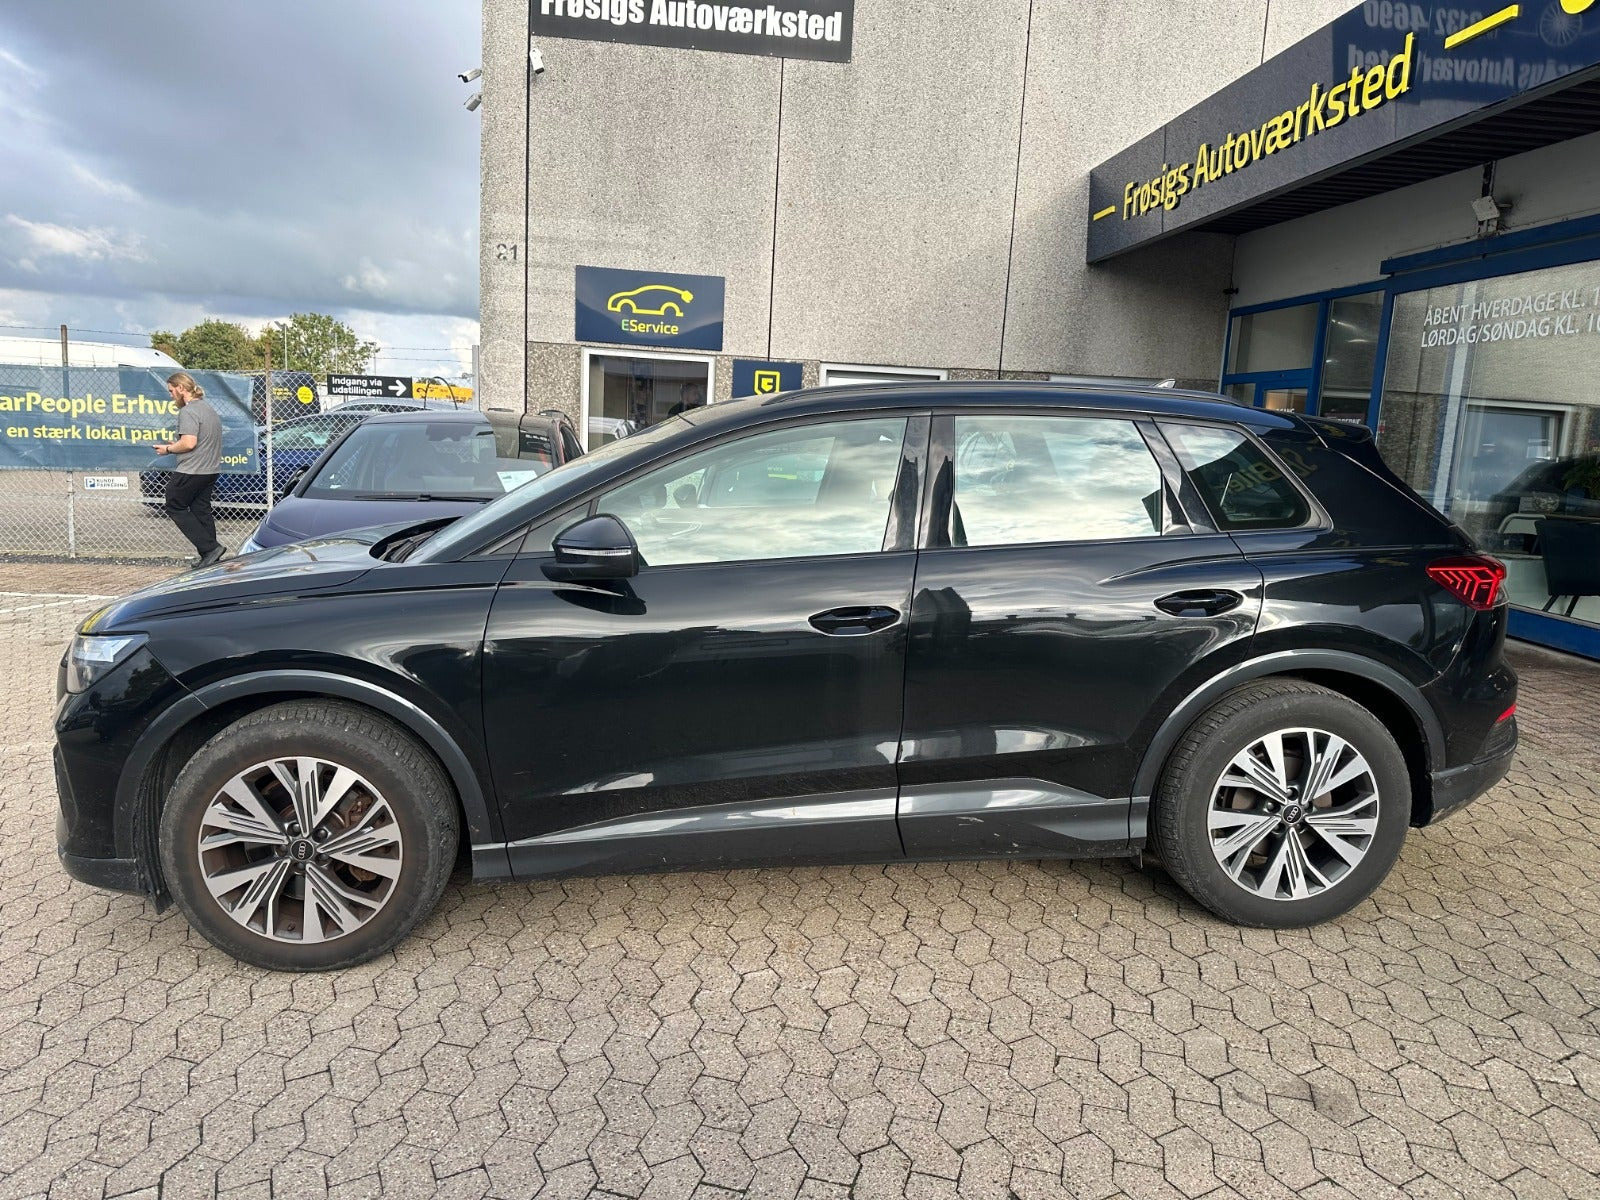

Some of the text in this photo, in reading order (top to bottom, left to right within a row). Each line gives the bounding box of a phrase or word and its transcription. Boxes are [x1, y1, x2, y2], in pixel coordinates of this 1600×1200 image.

[649, 0, 842, 42] Autoværksted
[1122, 32, 1415, 221] Frøsigs Autoværksted
[1423, 304, 1468, 326] ÅBENT
[1471, 292, 1557, 321] HVERDAGE
[1560, 289, 1585, 309] KL.
[621, 319, 679, 334] EService
[1421, 318, 1550, 347] LØRDAG/SØNDAG
[1554, 314, 1579, 335] KL.
[332, 377, 367, 387] Indgang
[332, 387, 382, 395] udstillingen
[7, 426, 29, 437] en
[33, 425, 81, 439] stærk
[86, 425, 126, 441] lokal
